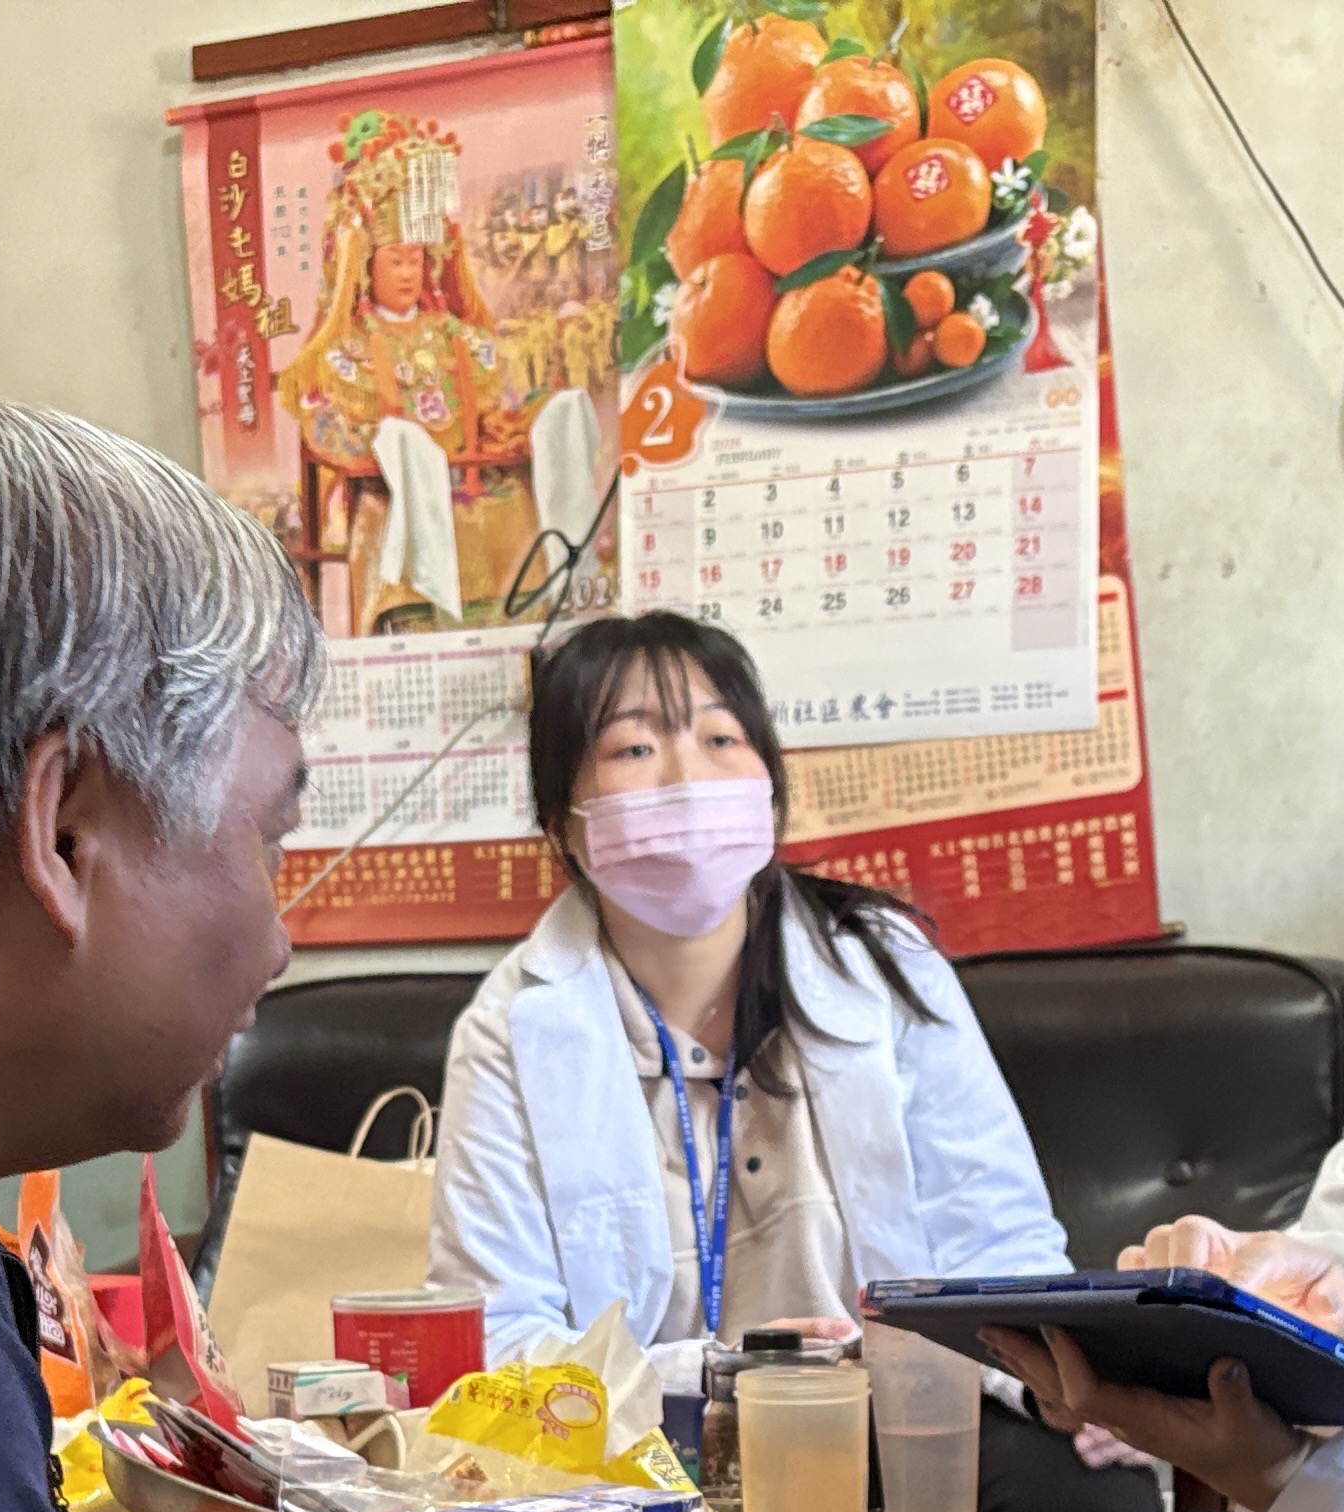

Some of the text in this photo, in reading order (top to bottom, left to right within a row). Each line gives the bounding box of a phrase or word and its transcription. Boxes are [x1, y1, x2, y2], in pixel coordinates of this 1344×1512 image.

[218, 149, 298, 340] 白沙屯媽祖
[641, 386, 674, 447] 2
[703, 489, 717, 508] 2
[763, 483, 778, 501] 3
[824, 477, 840, 496] 4
[891, 471, 905, 489] 5
[957, 463, 970, 482] 6
[1024, 456, 1037, 476] 7
[703, 527, 717, 545] 9
[761, 521, 784, 540] 10
[824, 515, 845, 534] 11
[888, 508, 910, 527] 12
[953, 502, 976, 522] 13
[1019, 496, 1042, 515] 14
[700, 565, 722, 583] 16
[761, 559, 783, 578] 17
[823, 553, 847, 573] 18
[887, 547, 911, 566] 19
[950, 541, 976, 561] 20
[1016, 536, 1041, 556] 21
[758, 597, 783, 616] 24
[821, 592, 847, 611] 25
[885, 586, 911, 606] 26
[950, 580, 976, 601] 27
[1016, 576, 1043, 595] 28
